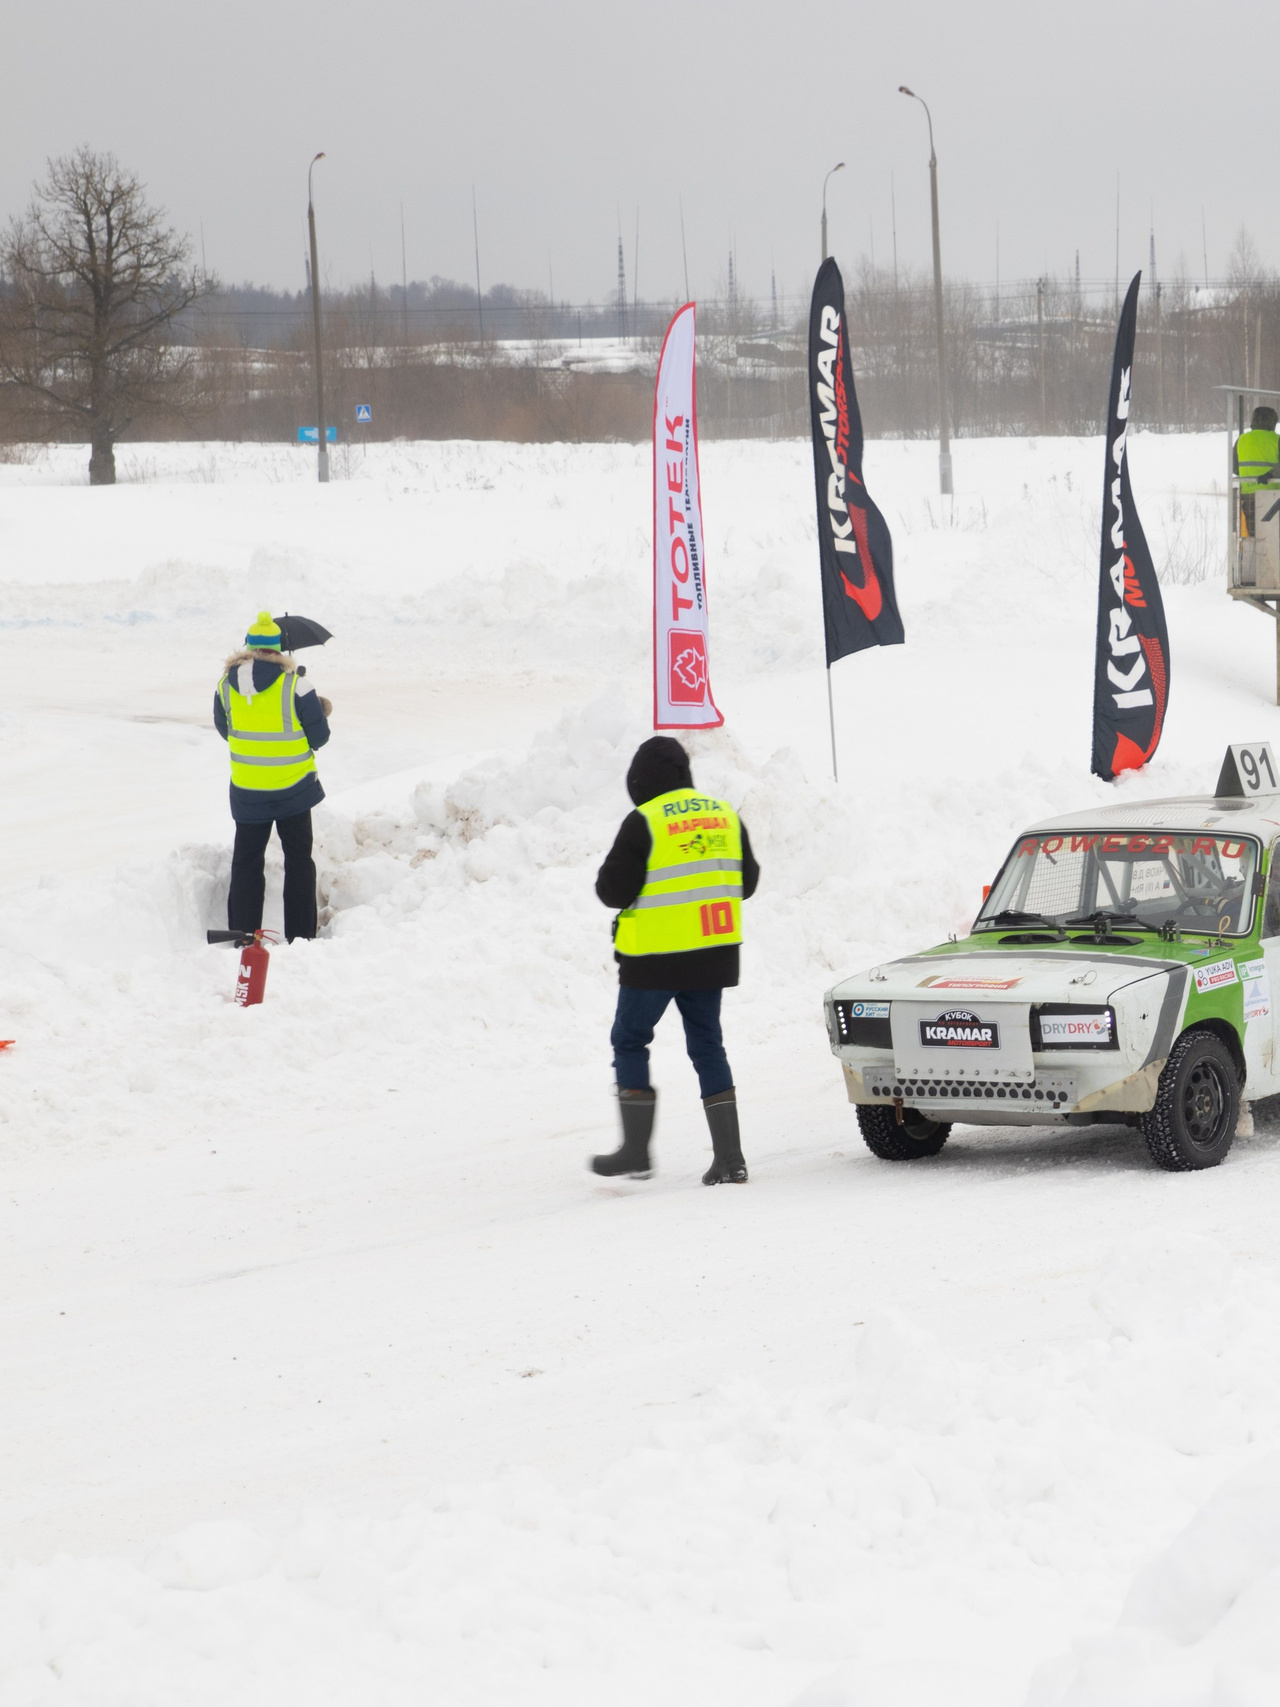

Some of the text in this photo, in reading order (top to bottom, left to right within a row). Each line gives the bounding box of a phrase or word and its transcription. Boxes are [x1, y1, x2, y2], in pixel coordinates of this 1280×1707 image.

[684, 419, 692, 511] ТЕХГИИ
[1240, 747, 1277, 791] 91
[662, 798, 723, 817] RUSTA
[1017, 834, 1248, 859] ROWE62.RU
[700, 901, 735, 937] 10
[235, 981, 249, 1007] MSK
[944, 1011, 973, 1022] КУБОК
[1042, 1023, 1092, 1035] DRYDRY
[925, 1026, 993, 1041] KRAMAR
